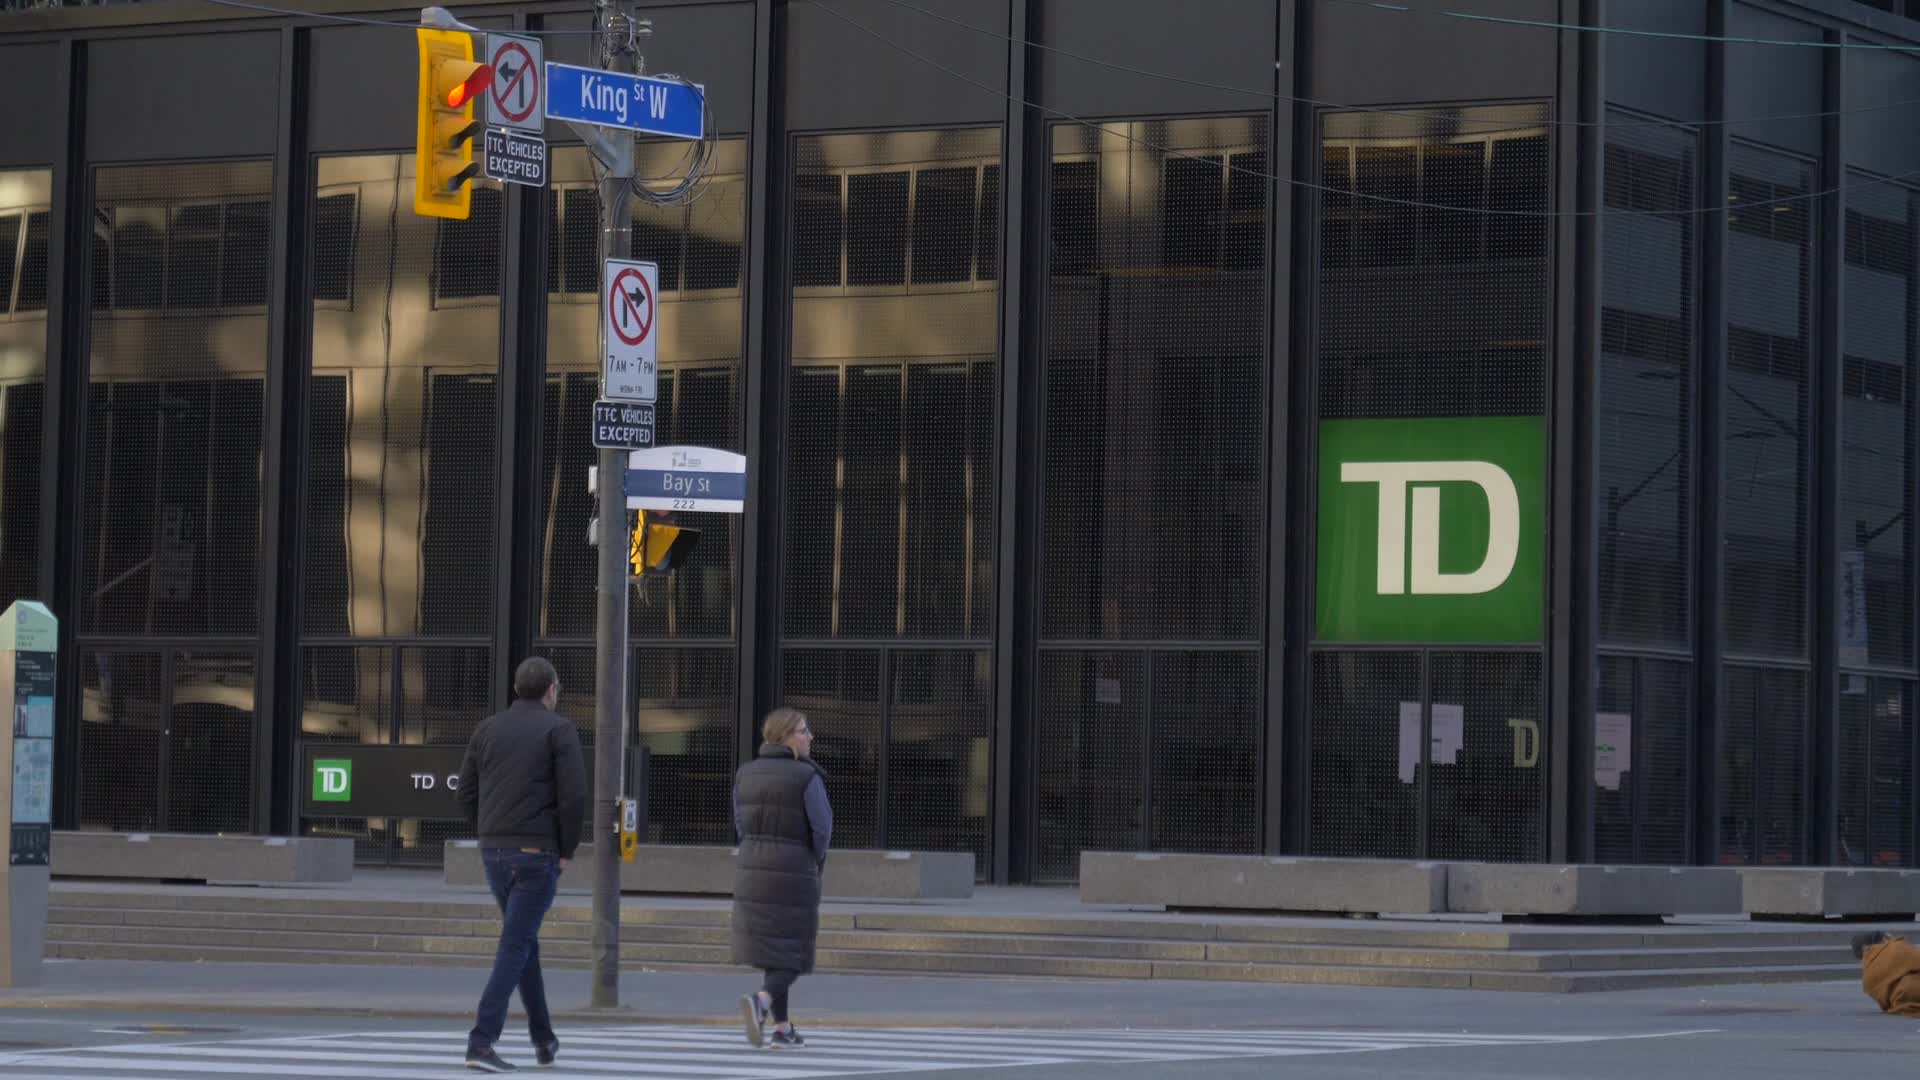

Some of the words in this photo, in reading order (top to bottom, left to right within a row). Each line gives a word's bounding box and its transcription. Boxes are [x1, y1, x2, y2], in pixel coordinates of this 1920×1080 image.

[581, 74, 628, 123] King
[633, 83, 645, 102] St
[649, 85, 668, 120] W
[488, 136, 504, 153] TTC
[506, 139, 543, 161] VEHICLES
[490, 156, 540, 178] EXCEPTED
[597, 407, 617, 422] TTC
[620, 408, 653, 425] VEHICLES
[599, 426, 651, 443] EXCEPTED
[663, 473, 694, 496] Bay
[697, 478, 710, 492] St
[673, 499, 695, 510] 222
[1341, 460, 1520, 595] TD
[317, 767, 347, 793] TD
[411, 773, 435, 790] TD
